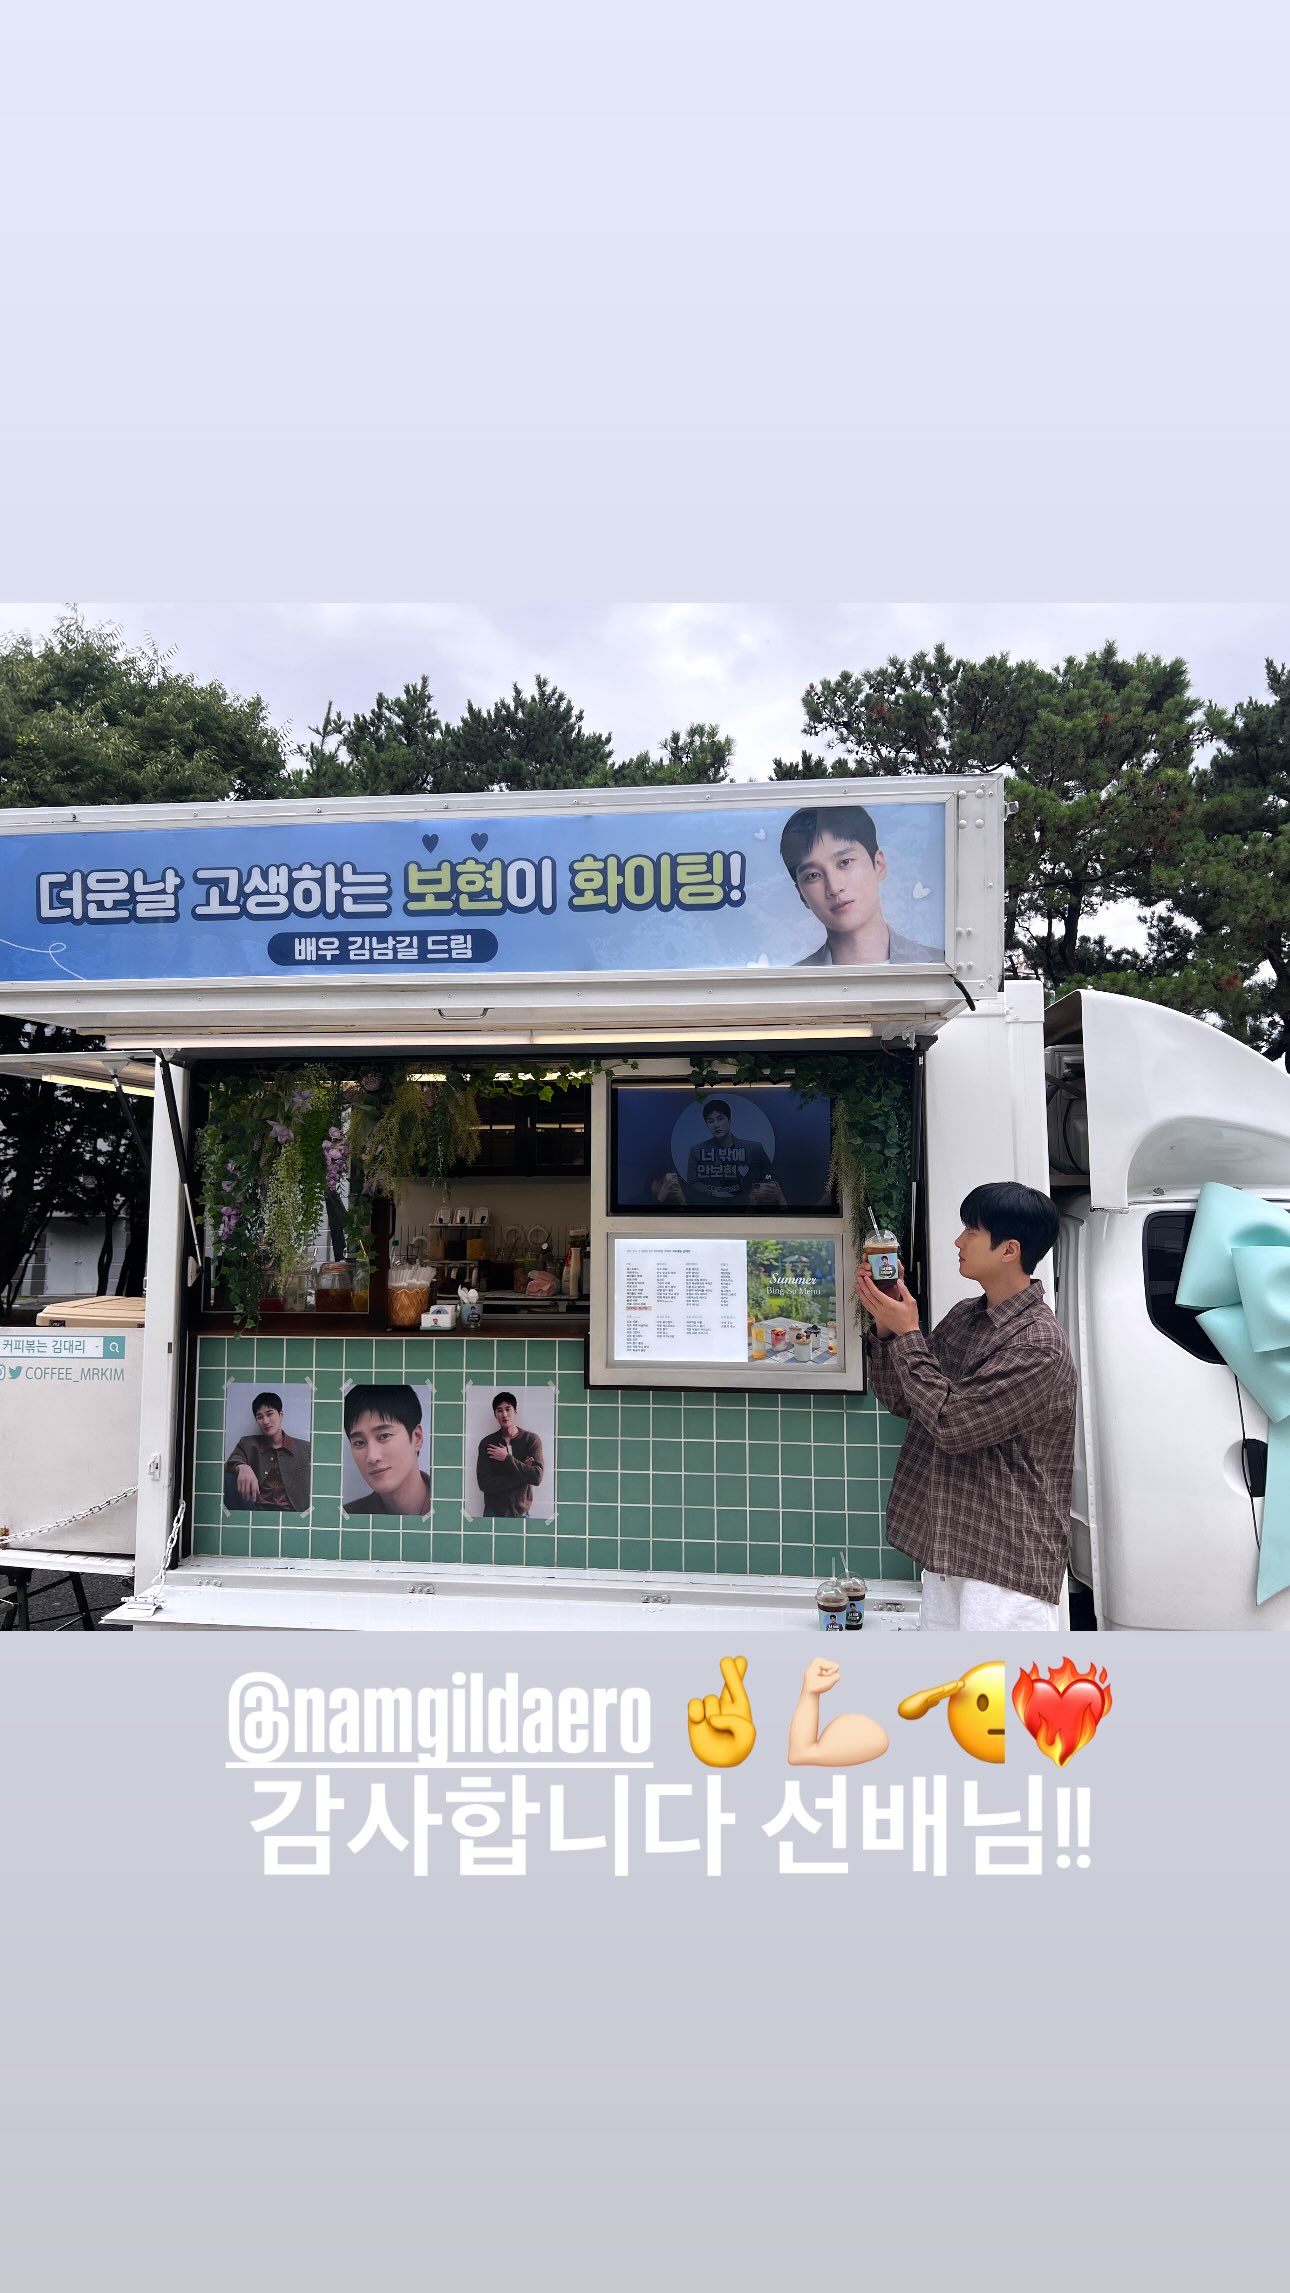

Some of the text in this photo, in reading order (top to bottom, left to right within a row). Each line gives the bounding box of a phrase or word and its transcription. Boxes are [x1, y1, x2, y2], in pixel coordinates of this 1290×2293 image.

[37, 851, 746, 923] 더운날 고생하는 보현이 화이팅!
[293, 933, 474, 961] 배우 김남길 드림
[701, 1147, 746, 1162] 너 밖에
[769, 1272, 817, 1285] Summer
[766, 1286, 821, 1296] Bing Su Menu
[2, 1339, 86, 1354] 커피볶는 김대리
[25, 1366, 125, 1382] COFFEE_MRKIM
